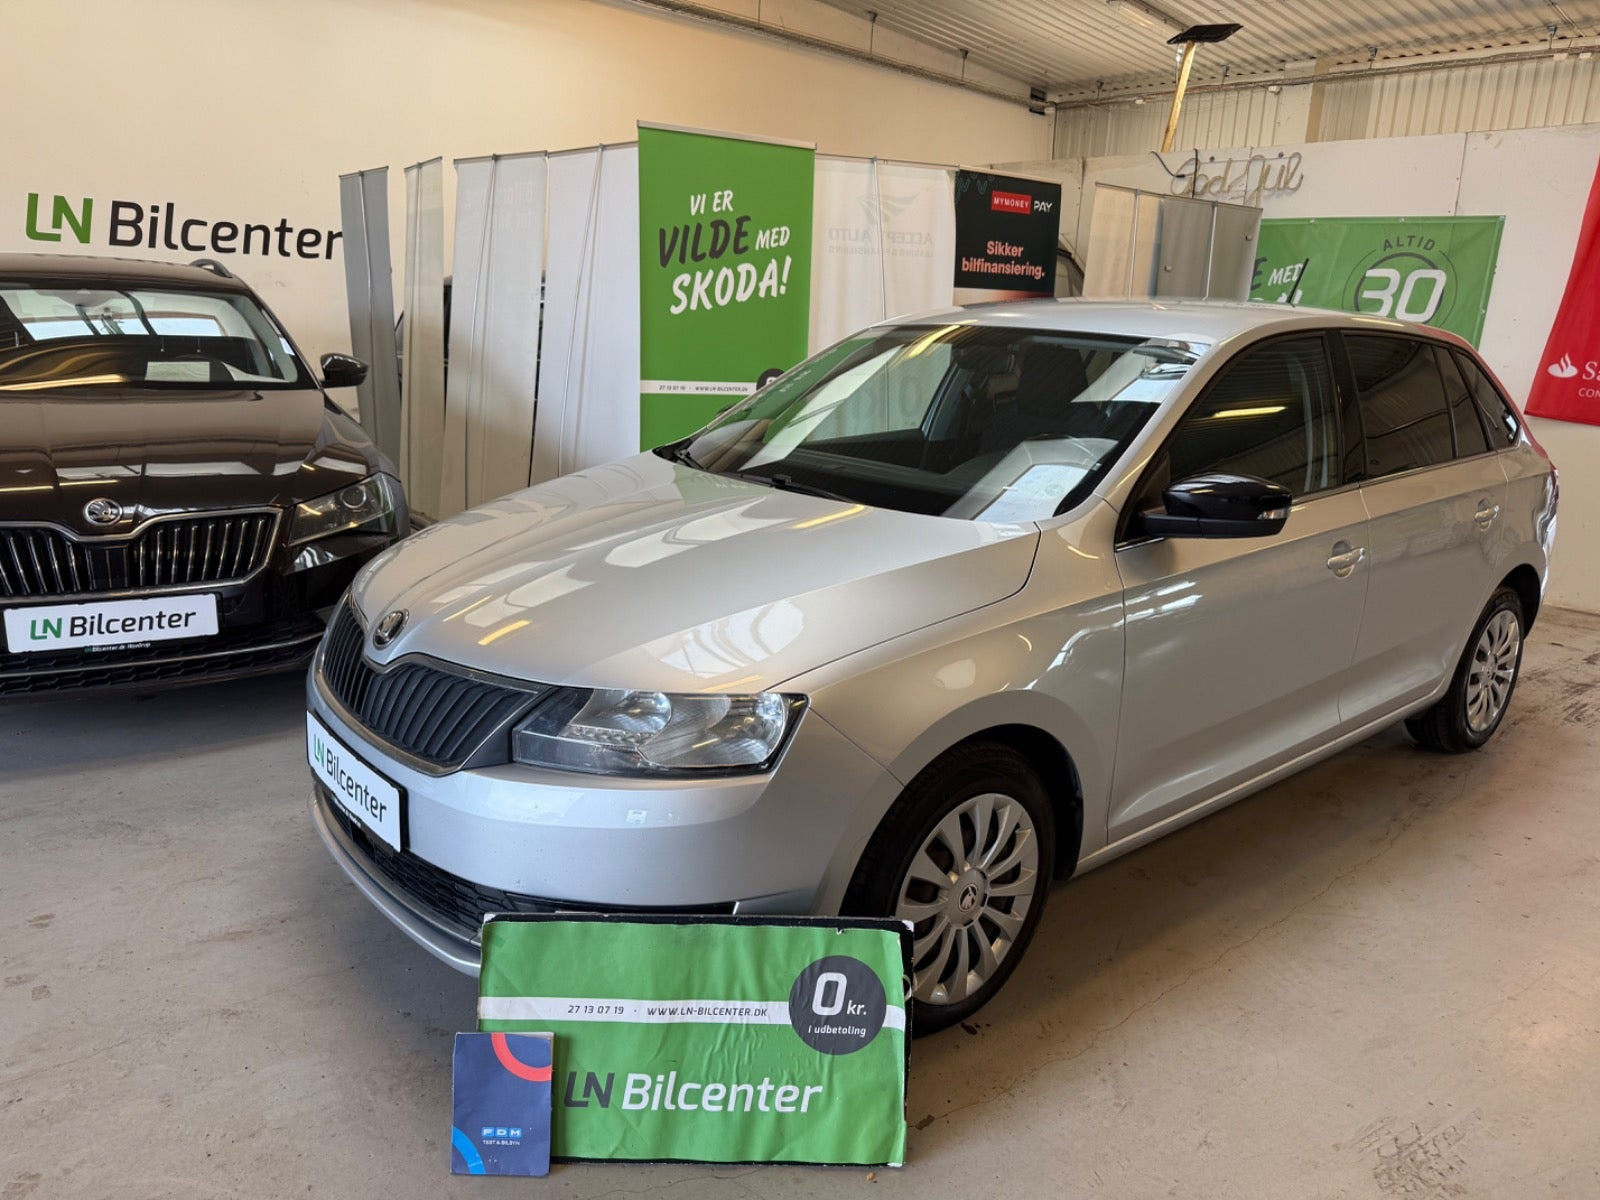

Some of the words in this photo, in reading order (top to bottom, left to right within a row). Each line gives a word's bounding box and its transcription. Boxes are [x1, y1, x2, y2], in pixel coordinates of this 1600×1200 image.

[690, 193, 706, 216] VI
[712, 190, 734, 213] ER
[993, 196, 1029, 209] MYMONEY
[1033, 200, 1053, 213] PAY
[25, 192, 94, 244] LN
[108, 200, 344, 260] Bilcenter
[658, 214, 752, 269] VILDE
[755, 226, 790, 251] MED
[986, 240, 1024, 257] Sikker
[1383, 234, 1436, 252] ALTID
[961, 257, 1045, 280] bilfinansiering.
[669, 255, 792, 316] SKODA!
[1360, 267, 1447, 324] 30
[30, 616, 62, 641] LN
[69, 610, 197, 638] Bilcenter
[314, 733, 325, 768] LN
[326, 746, 387, 823] Bilcenter
[812, 972, 847, 1016] 0
[847, 1000, 867, 1015] kr.
[567, 1005, 580, 1014] 27
[582, 1005, 594, 1014] 13
[597, 1005, 610, 1014] 07
[613, 1005, 625, 1014] 19
[647, 1007, 768, 1017] WWW.LN-BILCENTER.DK
[814, 1024, 867, 1038] udbetaling
[563, 1071, 616, 1108] LN
[622, 1071, 823, 1113] Bilcenter
[483, 1128, 521, 1136] FDM
